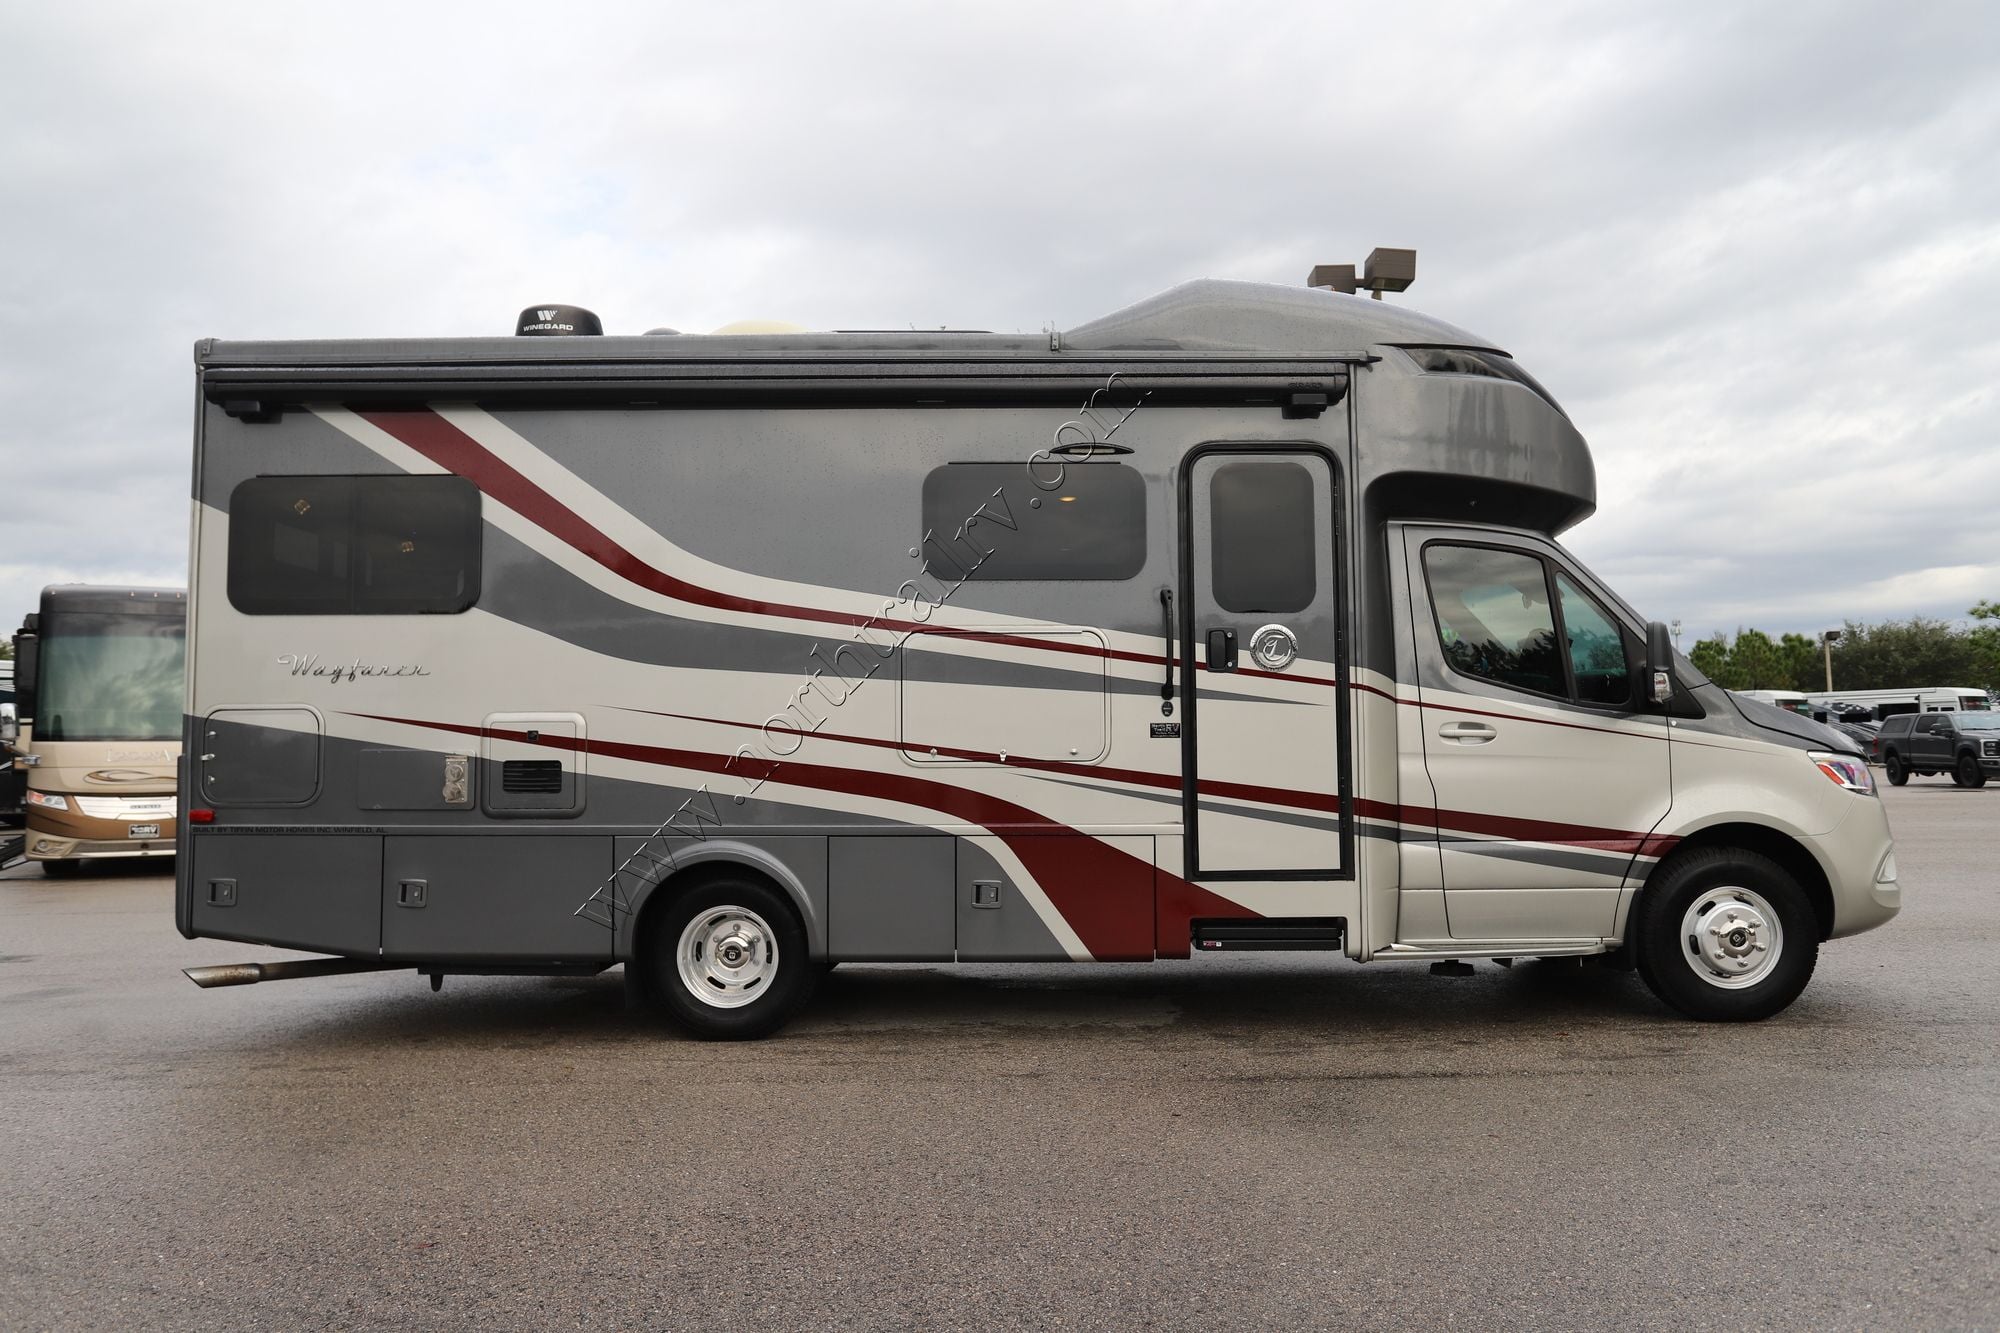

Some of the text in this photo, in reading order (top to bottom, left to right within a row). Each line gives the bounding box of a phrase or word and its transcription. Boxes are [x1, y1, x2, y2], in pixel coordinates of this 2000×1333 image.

[523, 323, 574, 332] WINEGARD
[277, 653, 431, 684] Wayfarer
[217, 826, 229, 834] BY
[230, 826, 254, 834] TIFFIN
[255, 826, 284, 834] MOTOR
[286, 826, 316, 834] HOMES
